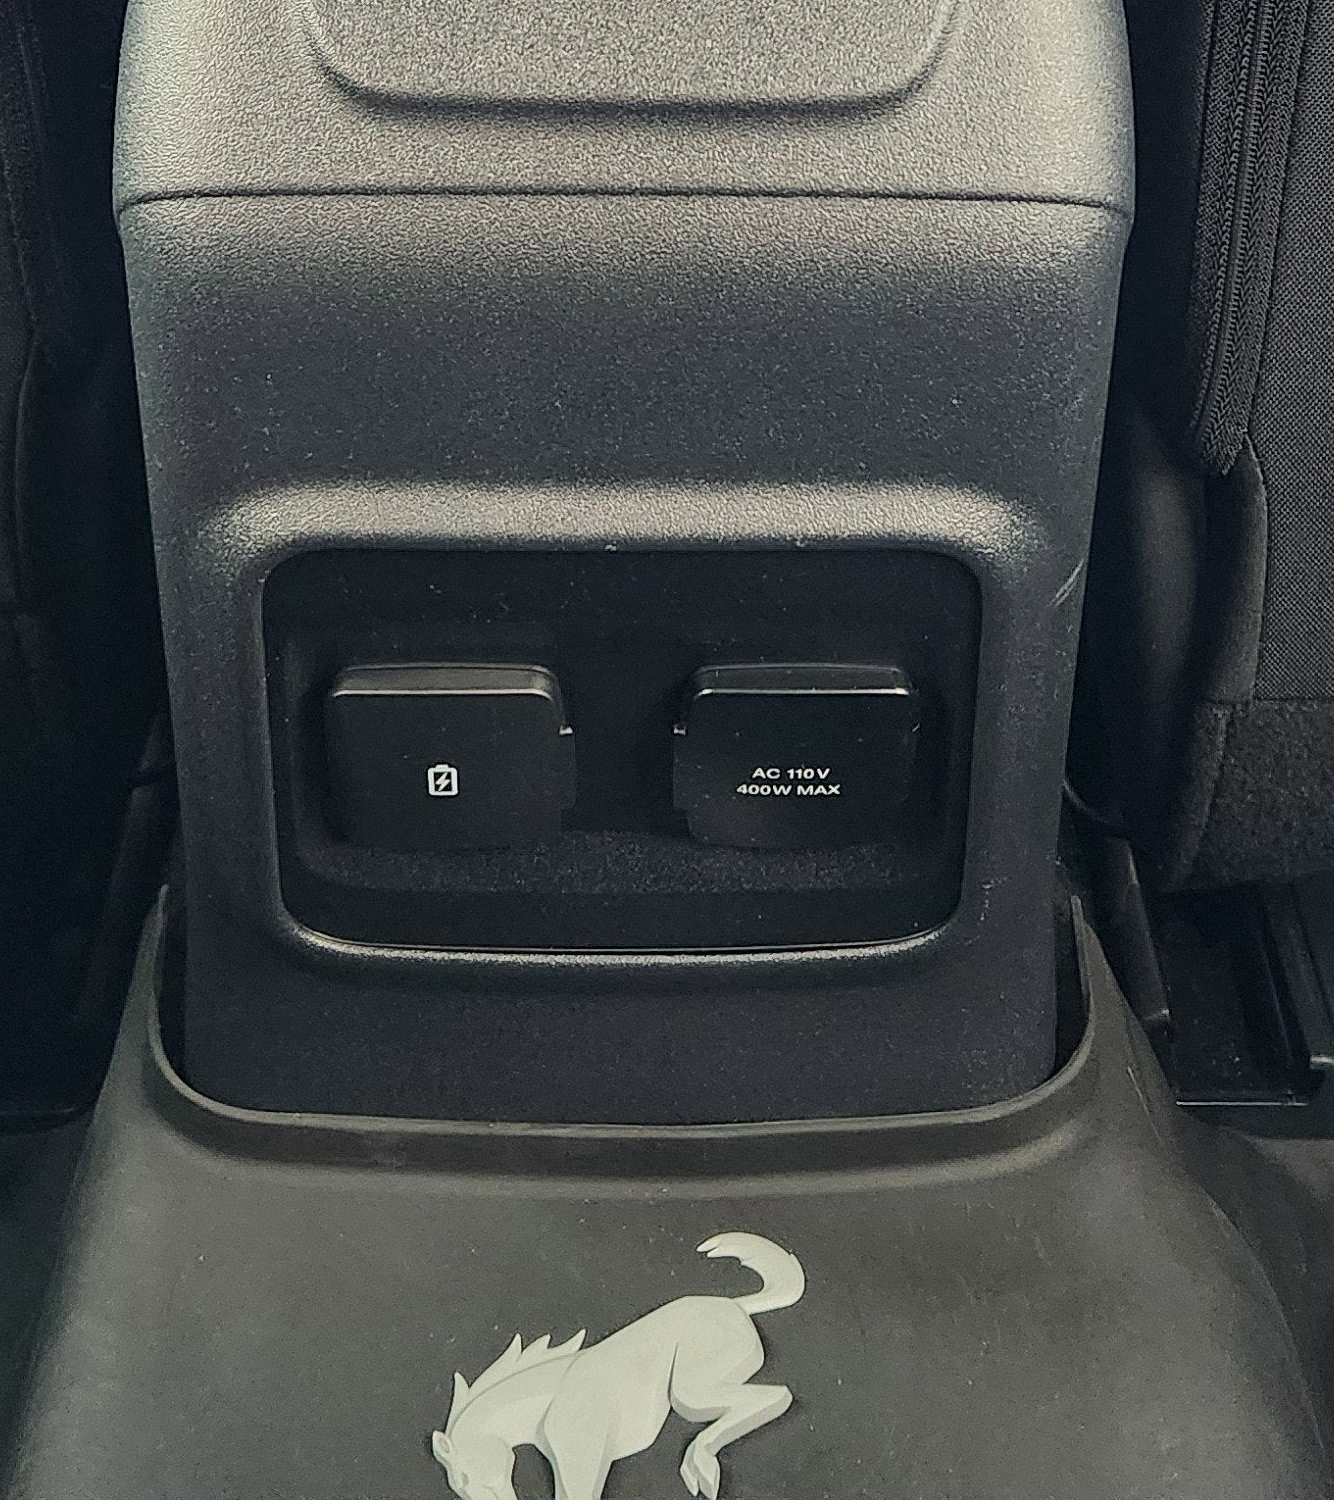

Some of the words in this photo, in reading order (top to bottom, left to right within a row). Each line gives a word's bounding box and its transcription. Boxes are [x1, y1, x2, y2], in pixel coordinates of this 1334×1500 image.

[752, 767, 781, 779] AC
[786, 768, 831, 779] 110V
[736, 784, 793, 795] 400W
[796, 784, 841, 795] MAX
